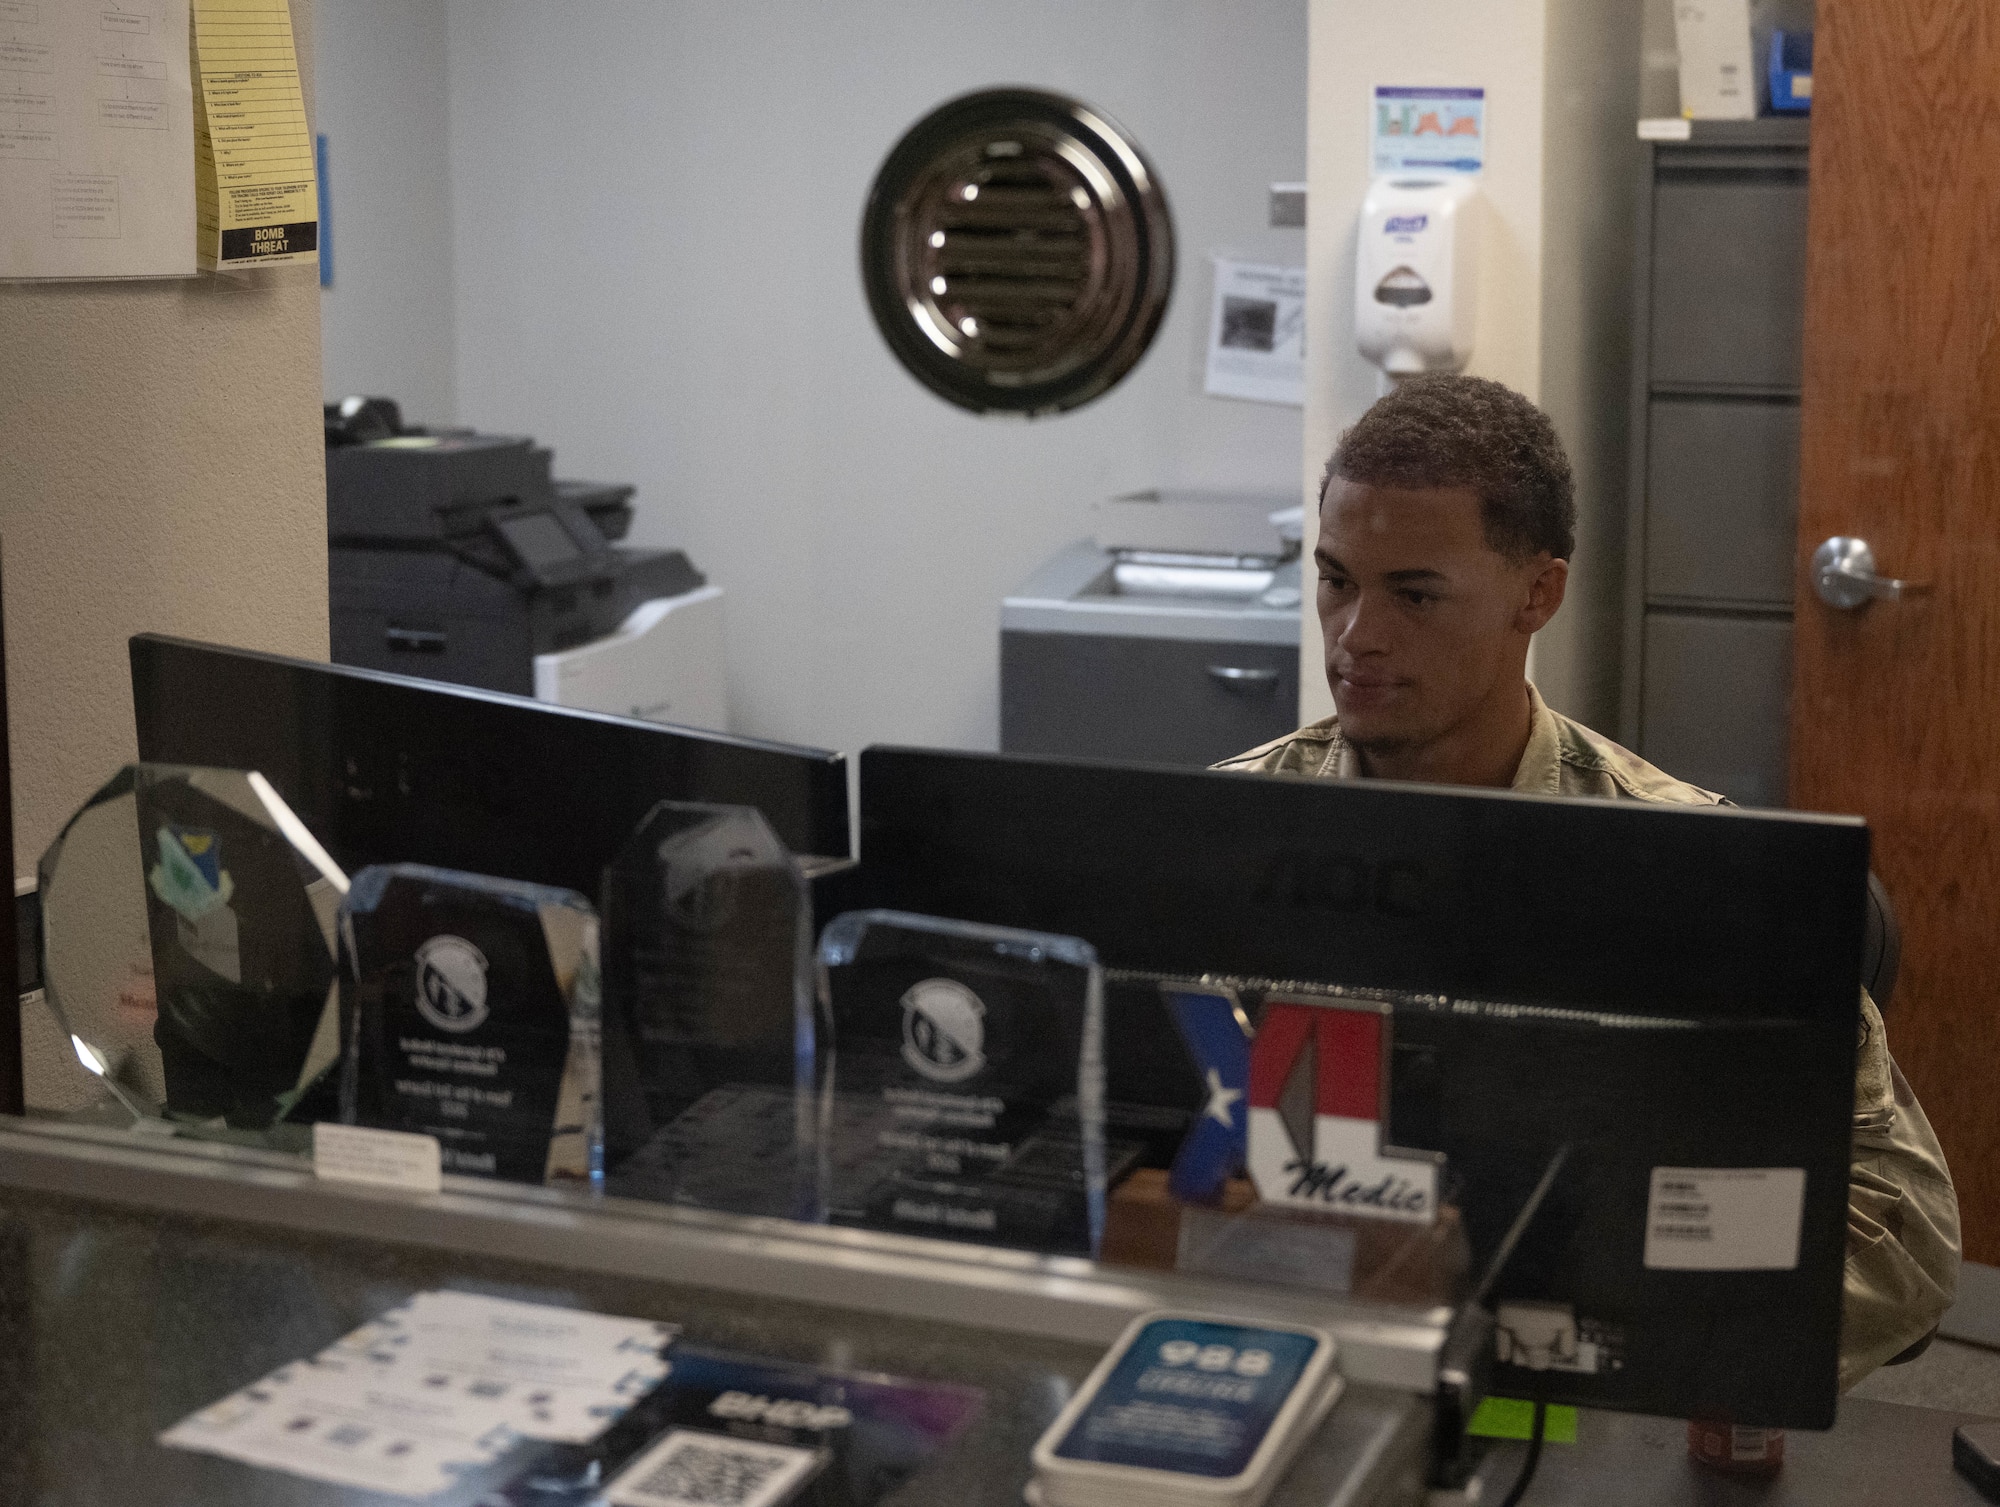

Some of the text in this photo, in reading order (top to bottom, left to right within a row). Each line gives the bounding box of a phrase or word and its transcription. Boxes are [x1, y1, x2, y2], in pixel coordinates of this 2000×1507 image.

[250, 240, 289, 254] THREAT
[254, 227, 285, 241] BOMB
[1283, 1163, 1425, 1211] Medic
[1158, 1339, 1274, 1378] 988
